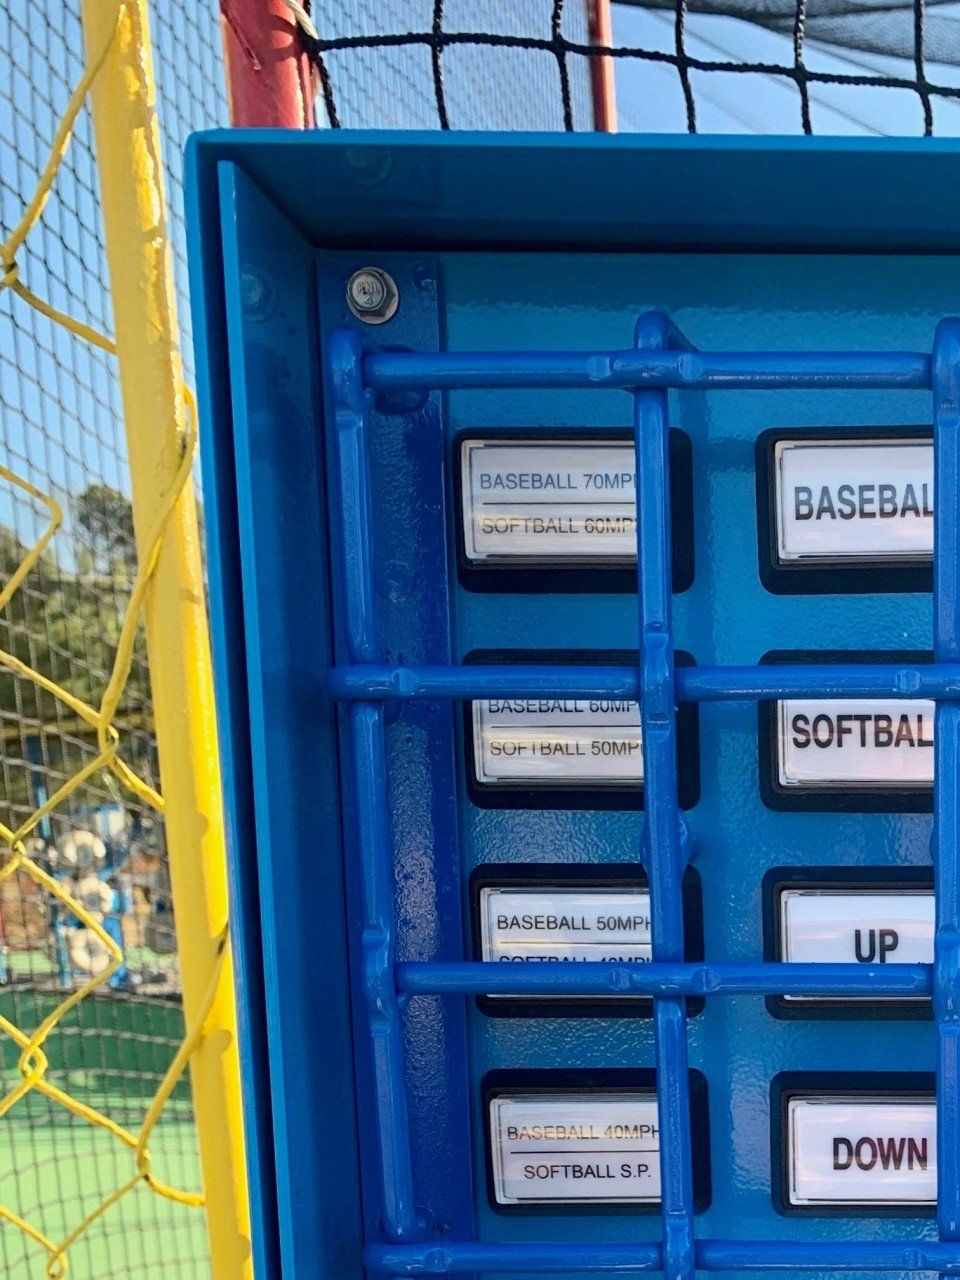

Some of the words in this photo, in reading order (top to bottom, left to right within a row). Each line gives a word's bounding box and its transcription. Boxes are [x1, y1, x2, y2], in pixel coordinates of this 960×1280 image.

[480, 473, 577, 490] BASEBALL
[583, 473, 637, 489] 70MP
[794, 483, 934, 521] BASEBAL
[482, 517, 578, 534] SOFTBALL
[584, 517, 637, 533] 60MP
[488, 700, 584, 713] BASEBALL
[590, 700, 638, 713] 60MP
[791, 713, 934, 749] SOFTBAL
[490, 740, 585, 756] SOFTBALL
[591, 740, 643, 756] 50MP
[497, 915, 591, 930] BASEBALL
[854, 929, 899, 963] UP
[507, 1125, 599, 1140] BASEBALL
[833, 1137, 928, 1171] DOWN
[524, 1164, 616, 1179] SOFTBALL
[620, 1164, 652, 1178] S.P.
